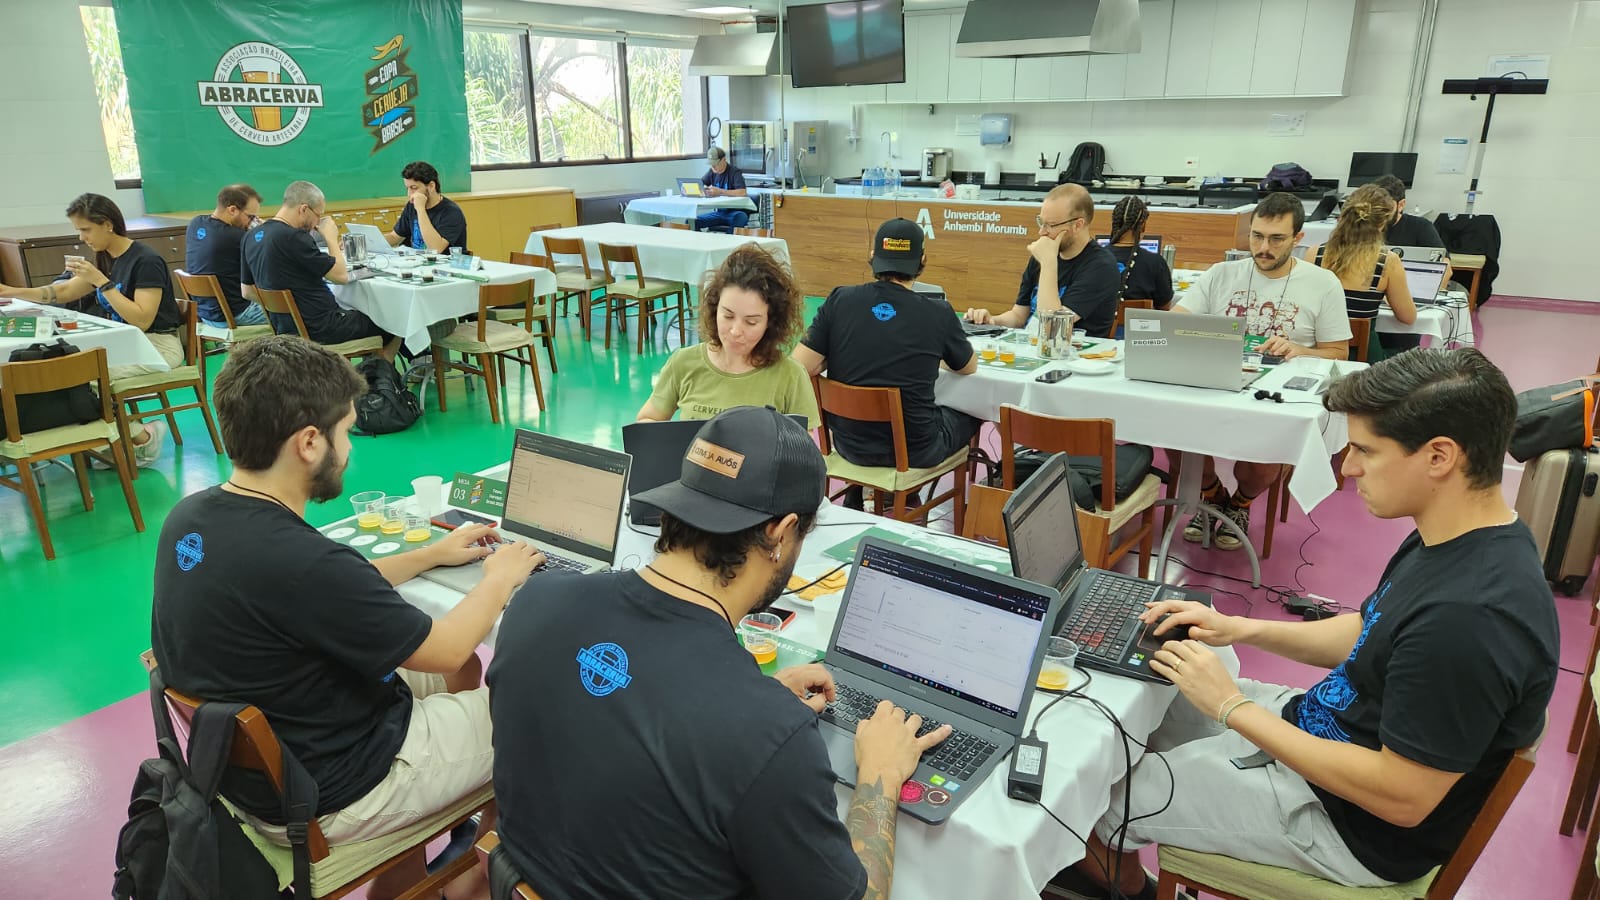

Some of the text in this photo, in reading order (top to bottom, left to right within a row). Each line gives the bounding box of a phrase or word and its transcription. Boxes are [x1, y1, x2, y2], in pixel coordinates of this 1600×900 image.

[221, 45, 298, 77] ASSOCIAÇÃO BRASILEIRA
[379, 60, 398, 84] COPA
[204, 86, 320, 104] ABRACERVA
[373, 84, 408, 118] CERVEJA
[229, 117, 304, 142] DE CERVEJA ARTESANAL
[381, 117, 405, 144] BRASIL
[943, 209, 1001, 222] Universidade
[943, 221, 1028, 235] Anhembi Morumbi
[693, 404, 726, 415] CERVE
[453, 487, 466, 500] 03
[579, 652, 627, 686] ABRACERVA
